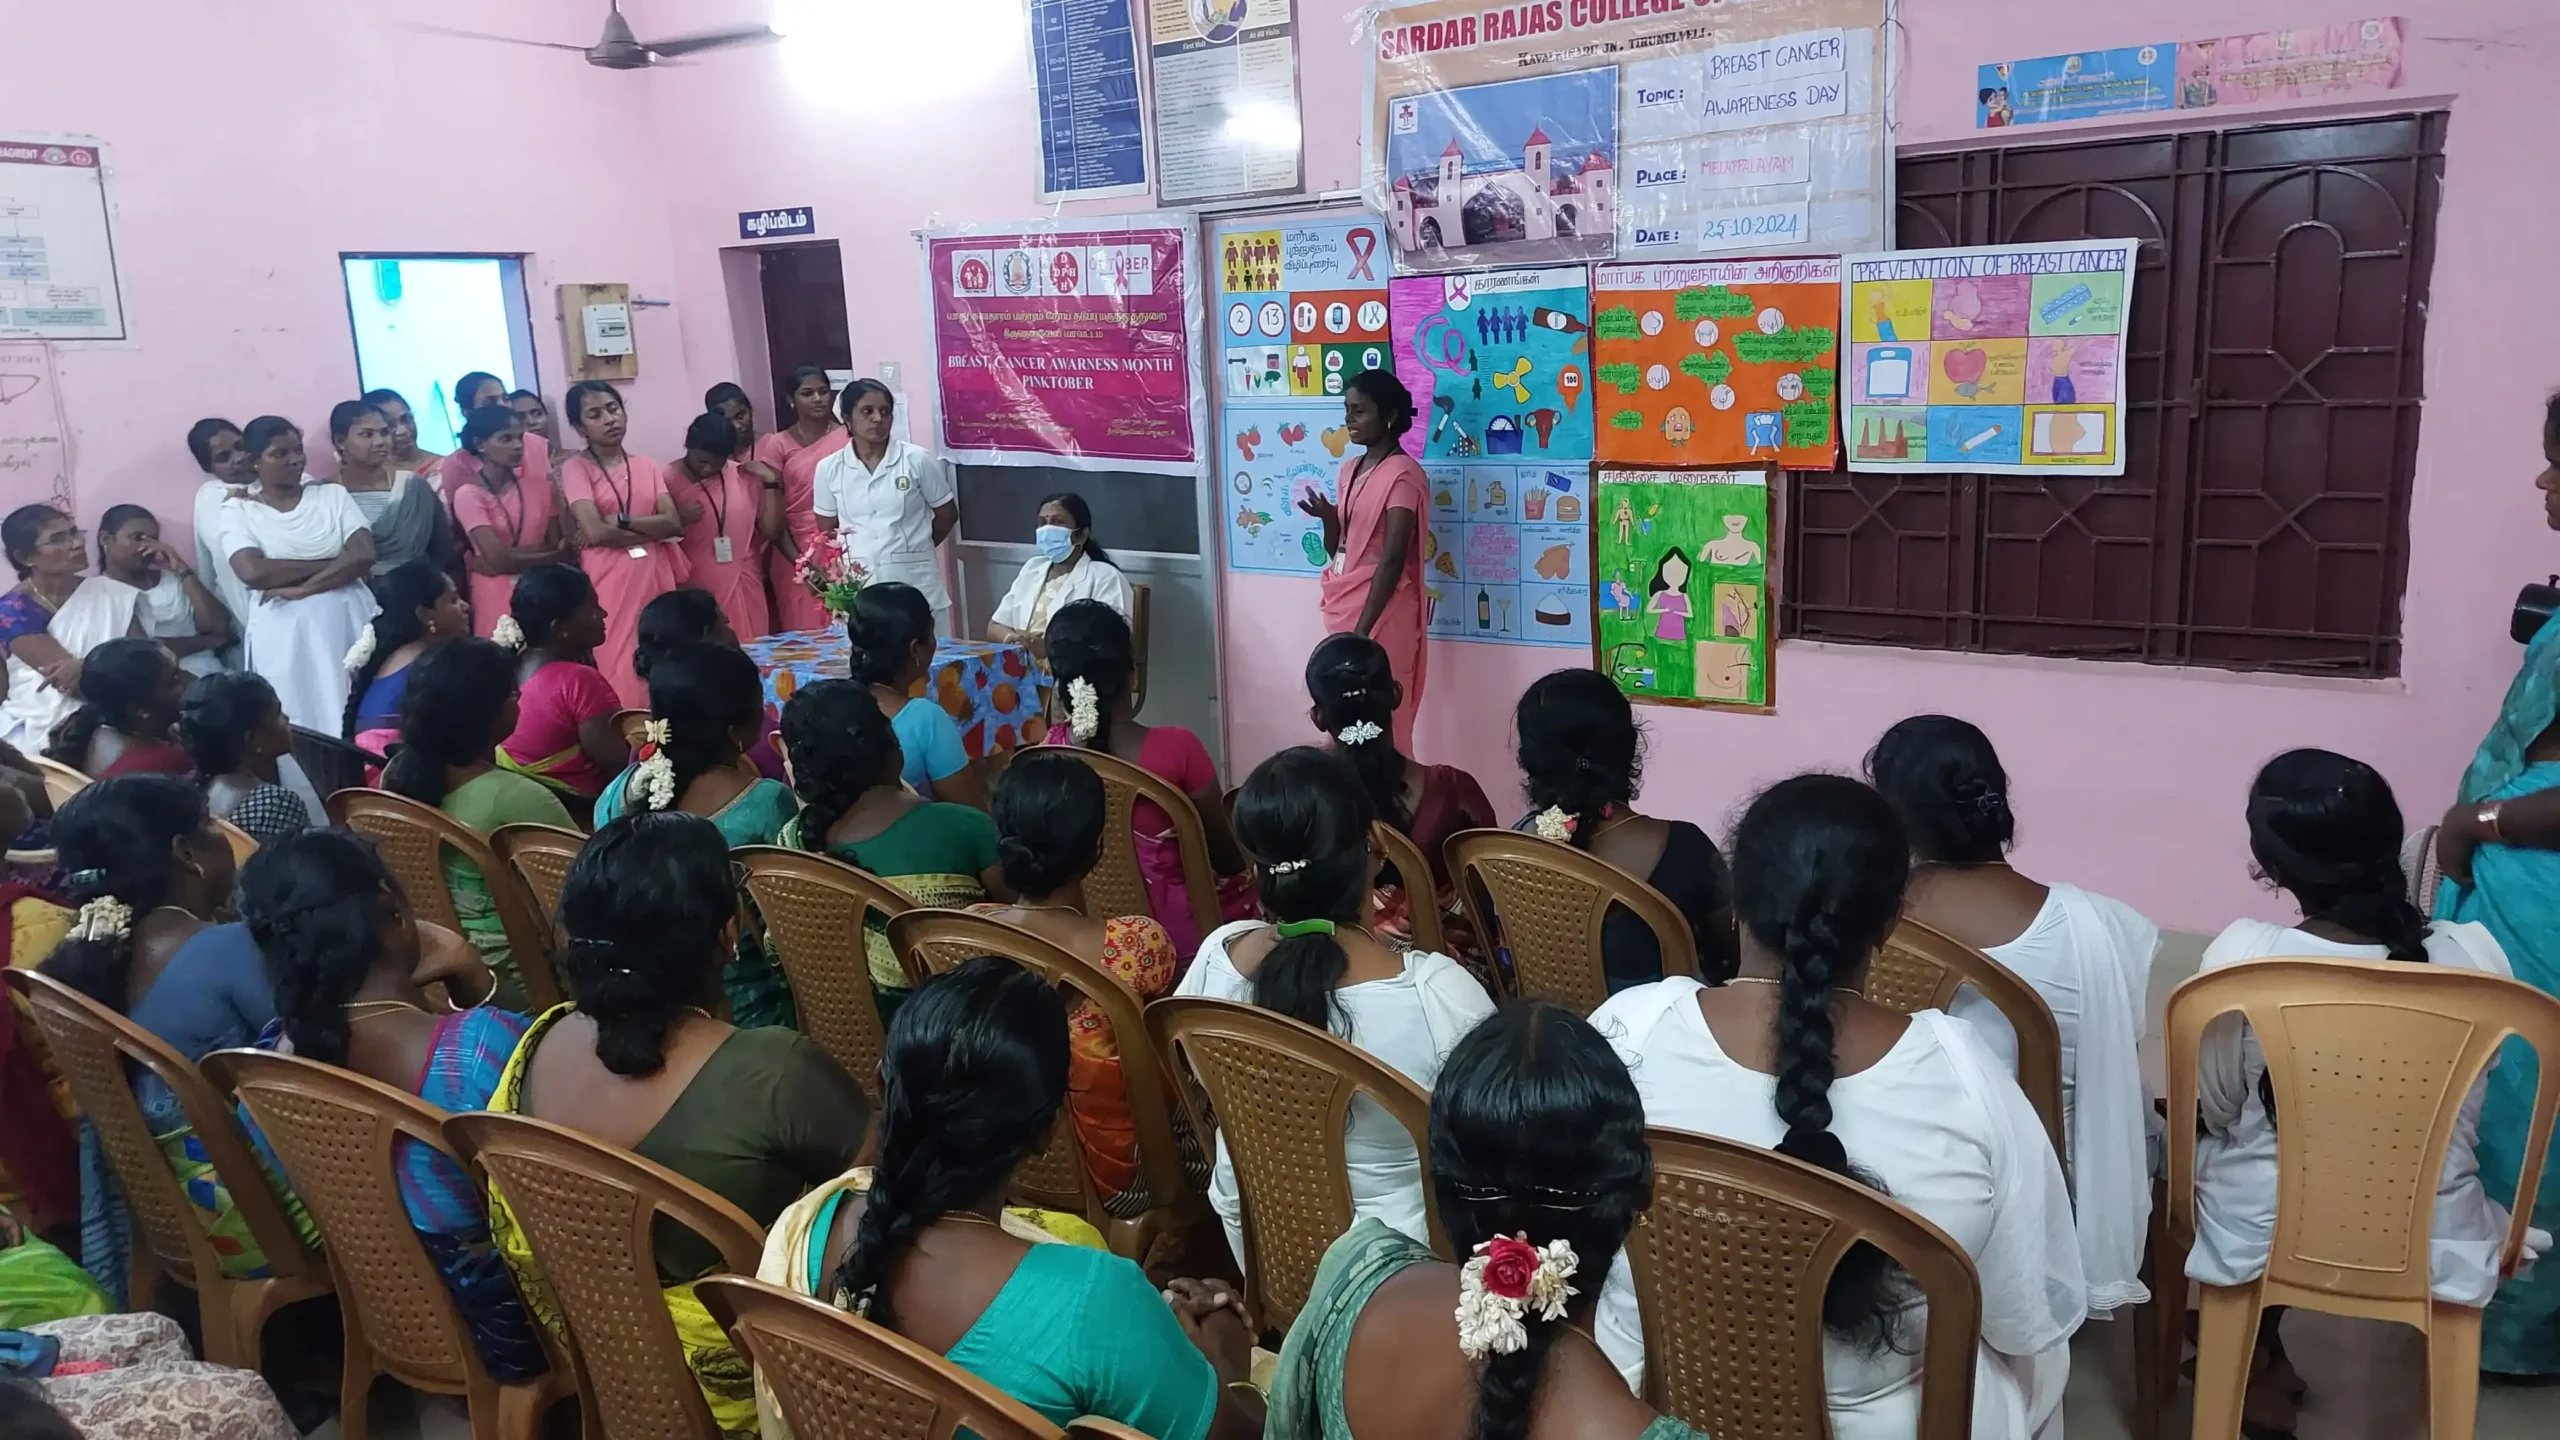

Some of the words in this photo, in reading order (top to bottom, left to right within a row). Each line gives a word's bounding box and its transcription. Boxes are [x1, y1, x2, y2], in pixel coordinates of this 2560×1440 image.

[1381, 16, 1476, 60] SARDAR
[1484, 1, 1562, 43] RAJAS
[1711, 50, 1771, 80] BREAST
[1775, 37, 1841, 67] CANCER
[1704, 91, 1797, 118] AWARENESS
[1805, 83, 1840, 106] DAY
[747, 209, 807, 236] கழிப்பிடம்
[1703, 213, 1800, 240] 25-10-2024
[1286, 229, 1320, 246] மார்பக
[1286, 239, 1337, 260] புற்றுநோய்
[1284, 257, 1339, 275] விழிப்புணர்வு
[1596, 268, 1645, 285] மார்பக
[1653, 263, 1749, 290] புற்றுநோயின்
[1754, 260, 1840, 286] அறிகுறிகள்
[1857, 256, 1973, 281] PREVENTION
[1983, 256, 2003, 276] OF
[2011, 251, 2065, 275] BREAST
[2069, 249, 2125, 272] CANCER
[1474, 272, 1540, 292] காரணங்கள்
[1236, 310, 1245, 323] 2
[1265, 308, 1280, 325] 13
[948, 355, 990, 369] BREAST
[995, 355, 1046, 370] CANCER
[1050, 357, 1118, 371] AWARNESS
[1121, 358, 1173, 372] MONTH
[1022, 375, 1095, 390] PINKTOBER
